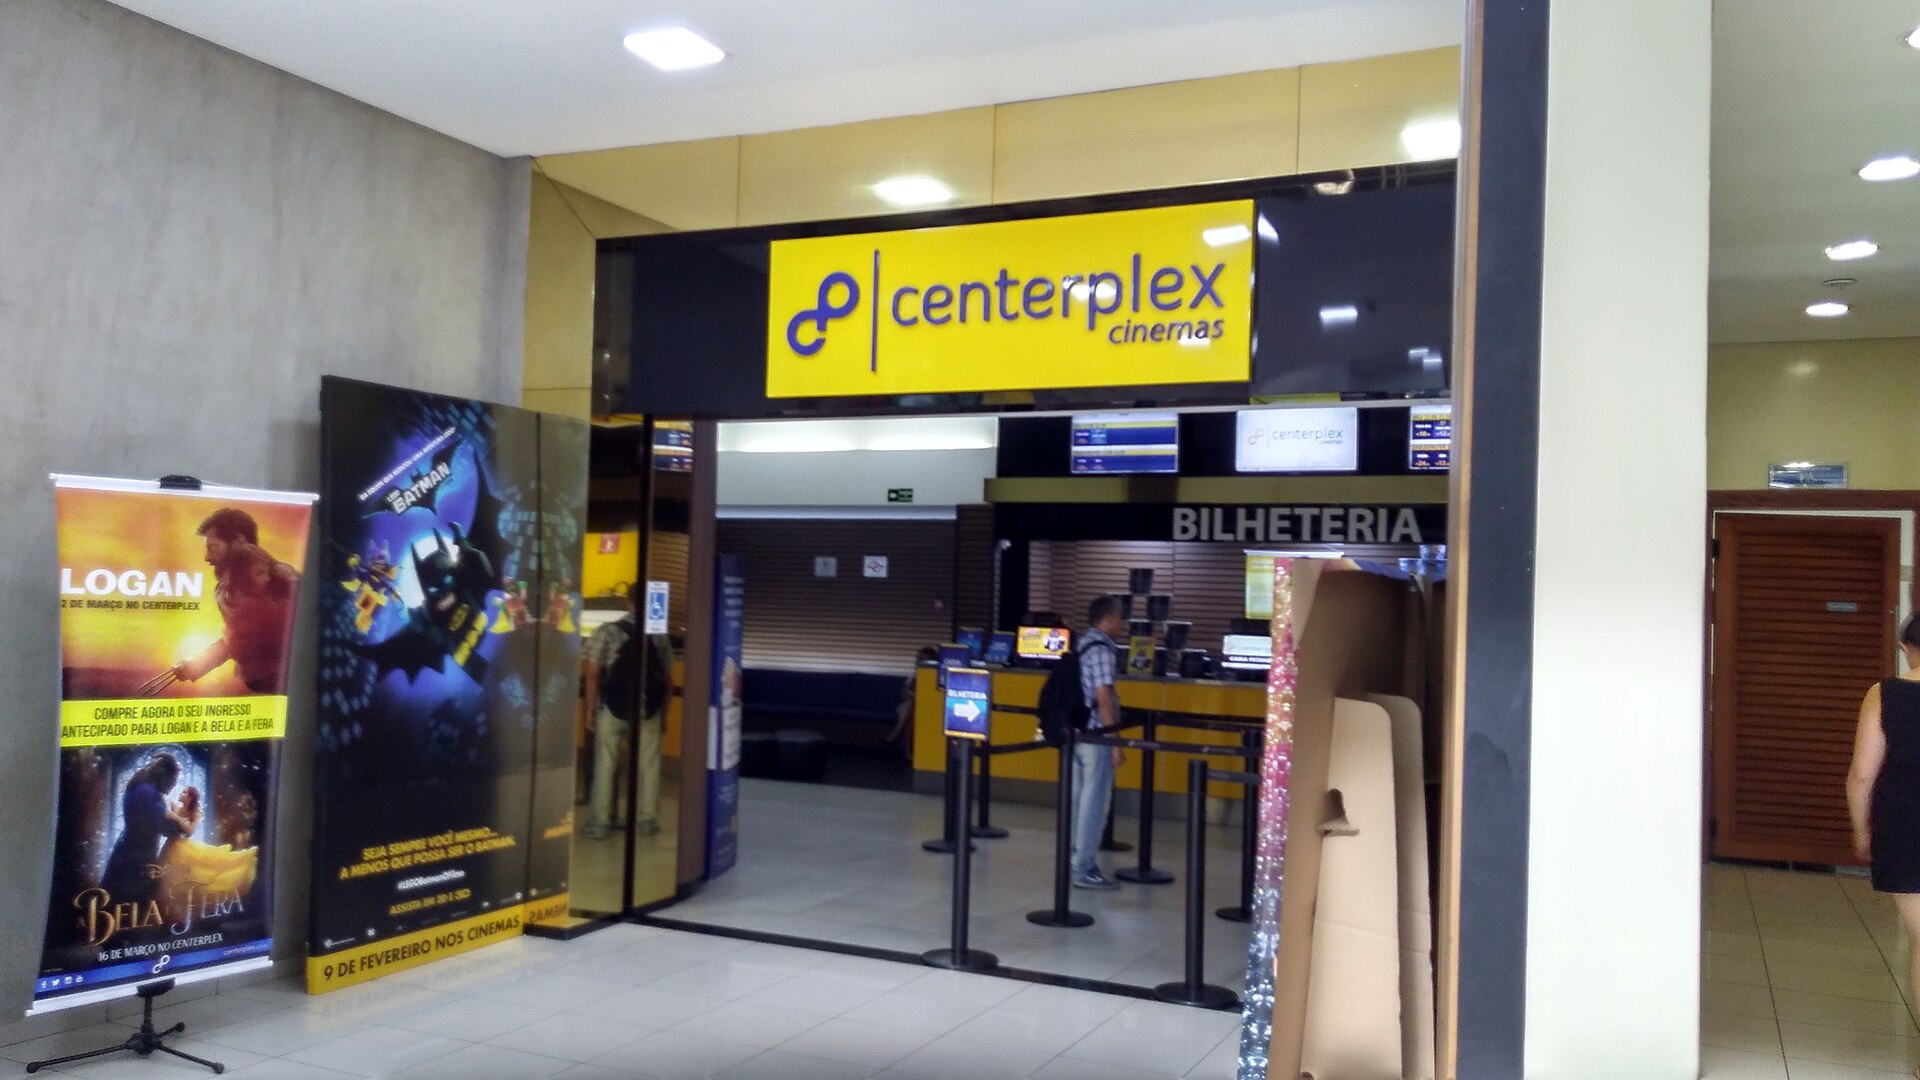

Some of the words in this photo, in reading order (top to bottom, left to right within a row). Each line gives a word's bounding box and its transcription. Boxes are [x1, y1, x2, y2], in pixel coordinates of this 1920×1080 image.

[892, 253, 1226, 331] centerplex
[1108, 317, 1225, 345] cinemas
[1272, 427, 1343, 441] centerplex
[392, 462, 450, 514] BATMAN
[1172, 507, 1422, 543] BILHETERIA
[61, 568, 203, 597] LOGAN
[61, 600, 68, 608] 2
[70, 600, 84, 608] DE
[87, 601, 123, 612] MARÇO
[127, 601, 139, 609] NO
[142, 601, 200, 611] CENTERPLEX
[947, 689, 988, 699] BILHETERIA
[94, 706, 138, 720] COMPRE
[141, 705, 175, 718] AGORA
[178, 705, 183, 717] O
[186, 705, 202, 717] SEU
[205, 704, 251, 717] INGRESSO
[61, 723, 128, 738] ANTECIPADO
[133, 722, 159, 736] PARA
[161, 721, 192, 735] LOGAN
[193, 721, 199, 732] E
[201, 721, 207, 732] A
[211, 720, 235, 732] BELA
[238, 719, 243, 731] E
[245, 719, 251, 730] A
[253, 718, 274, 730] FERA
[388, 838, 427, 853] SEMPRE
[339, 867, 349, 880] A
[350, 859, 390, 877] MENOS
[390, 854, 412, 869] QUE
[414, 849, 447, 864] POSSA
[447, 844, 464, 857] SER
[465, 843, 473, 855] O
[73, 887, 164, 947] BELA
[169, 881, 244, 936] FERA
[388, 899, 422, 916] ASSISTA
[99, 951, 109, 962] 16
[111, 949, 123, 960] DE
[124, 944, 156, 958] MARÇO
[157, 942, 171, 953] NO
[171, 932, 224, 951] CENTERPLEX
[323, 965, 333, 982] 9
[338, 958, 356, 979] DE
[359, 939, 432, 974] FEVEREIRO
[435, 929, 464, 952] NOS
[467, 914, 520, 944] CINEMAS
